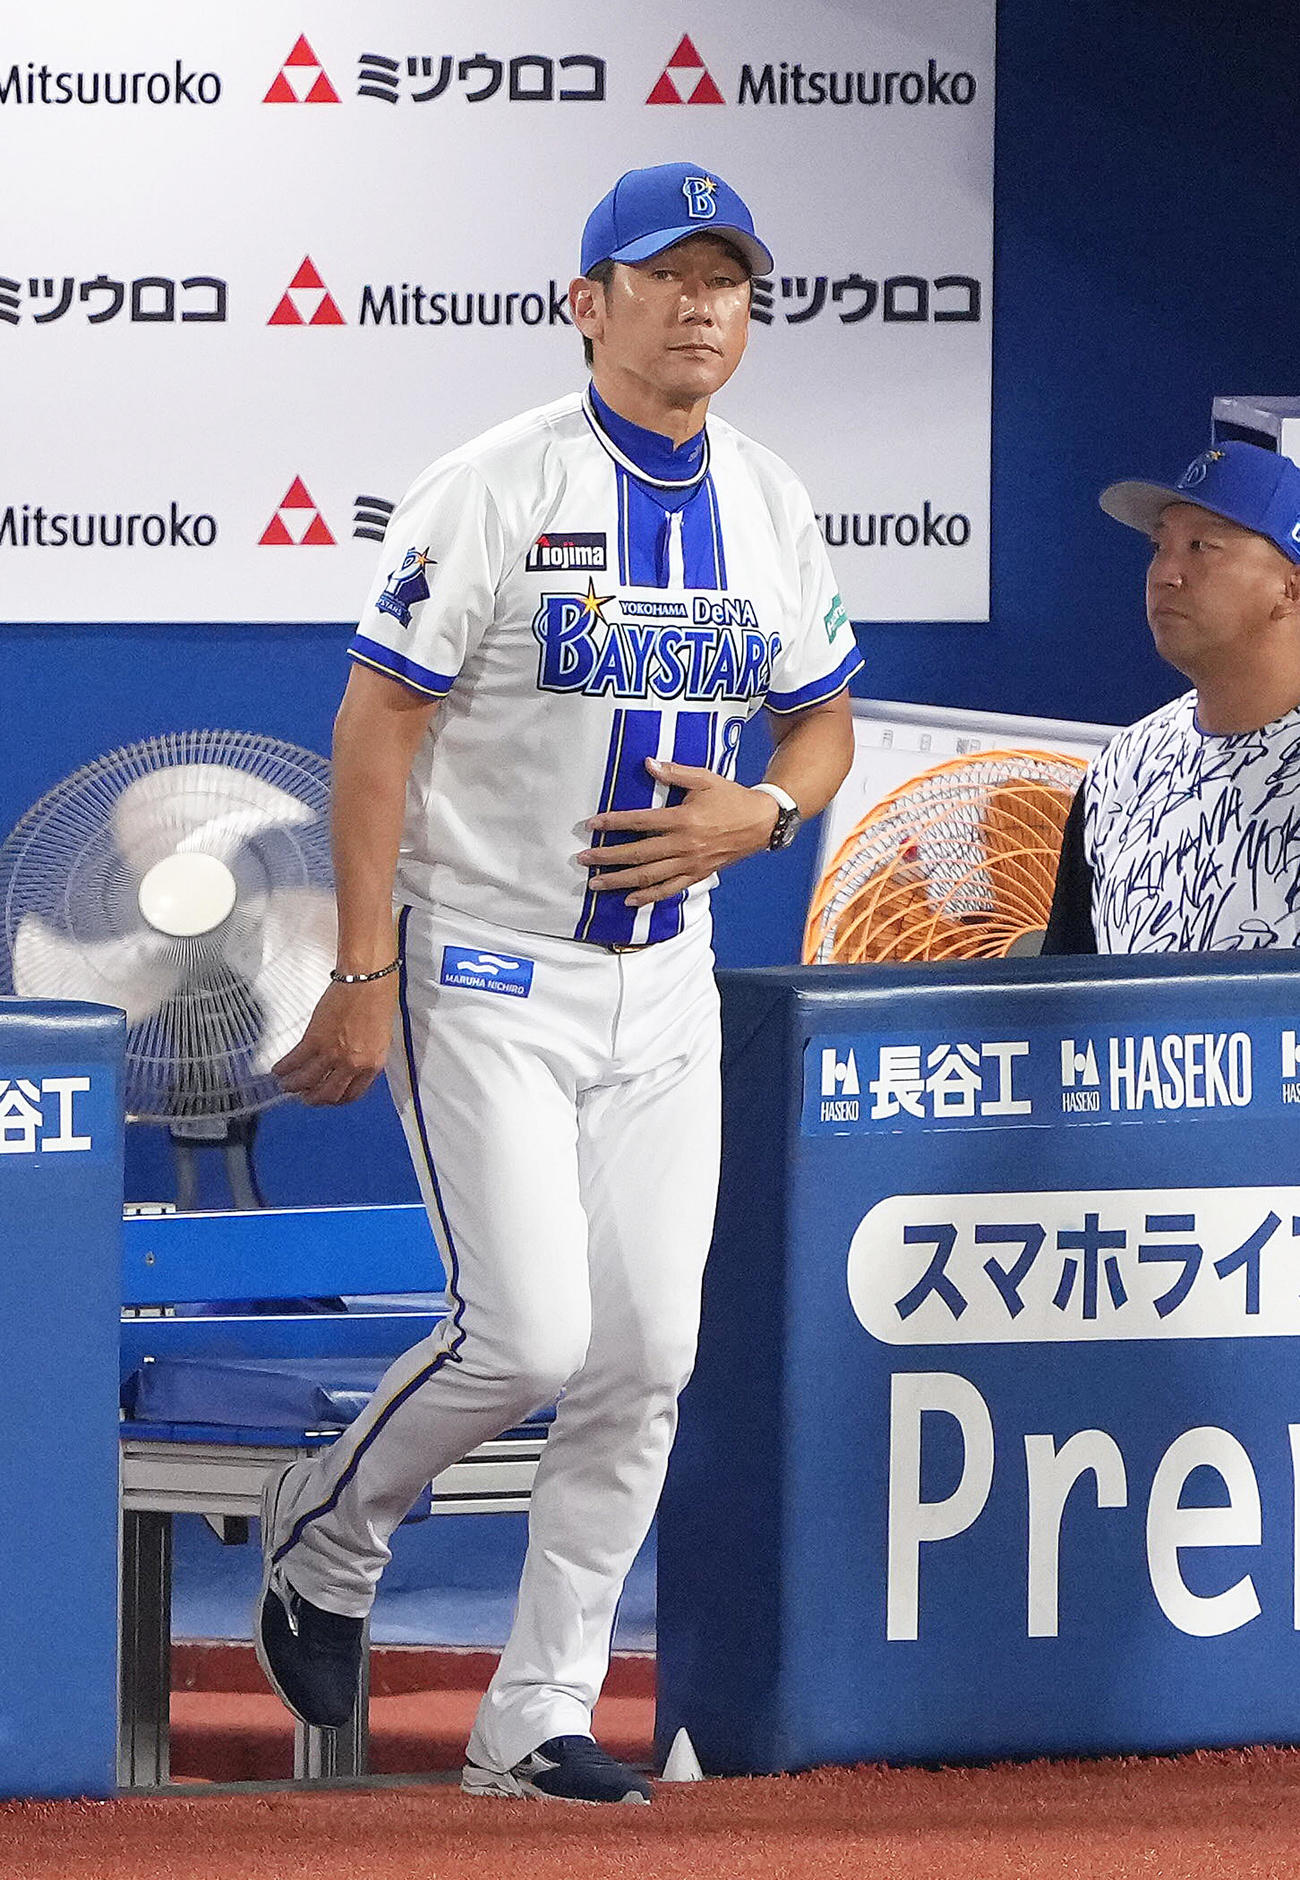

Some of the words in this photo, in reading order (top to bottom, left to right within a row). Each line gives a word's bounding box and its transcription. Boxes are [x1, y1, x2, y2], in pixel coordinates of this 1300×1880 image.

[358, 53, 607, 105] ミツウロコ
[738, 59, 978, 106] Mitsuuroko
[360, 281, 573, 327] Mitsuurok
[815, 501, 972, 548] uuroko
[620, 600, 688, 618] YOKOHAMA
[692, 597, 758, 627] DeNA
[445, 974, 486, 988] MARUHA
[487, 981, 525, 995] NICHIRO
[869, 1040, 1032, 1121] 長谷工
[1109, 1031, 1253, 1112] HASEKO
[820, 1100, 861, 1122] HASEKO
[1061, 1090, 1101, 1113] HASEKO
[894, 1210, 1300, 1322] スマホライ
[886, 1372, 1300, 1642] Pre
